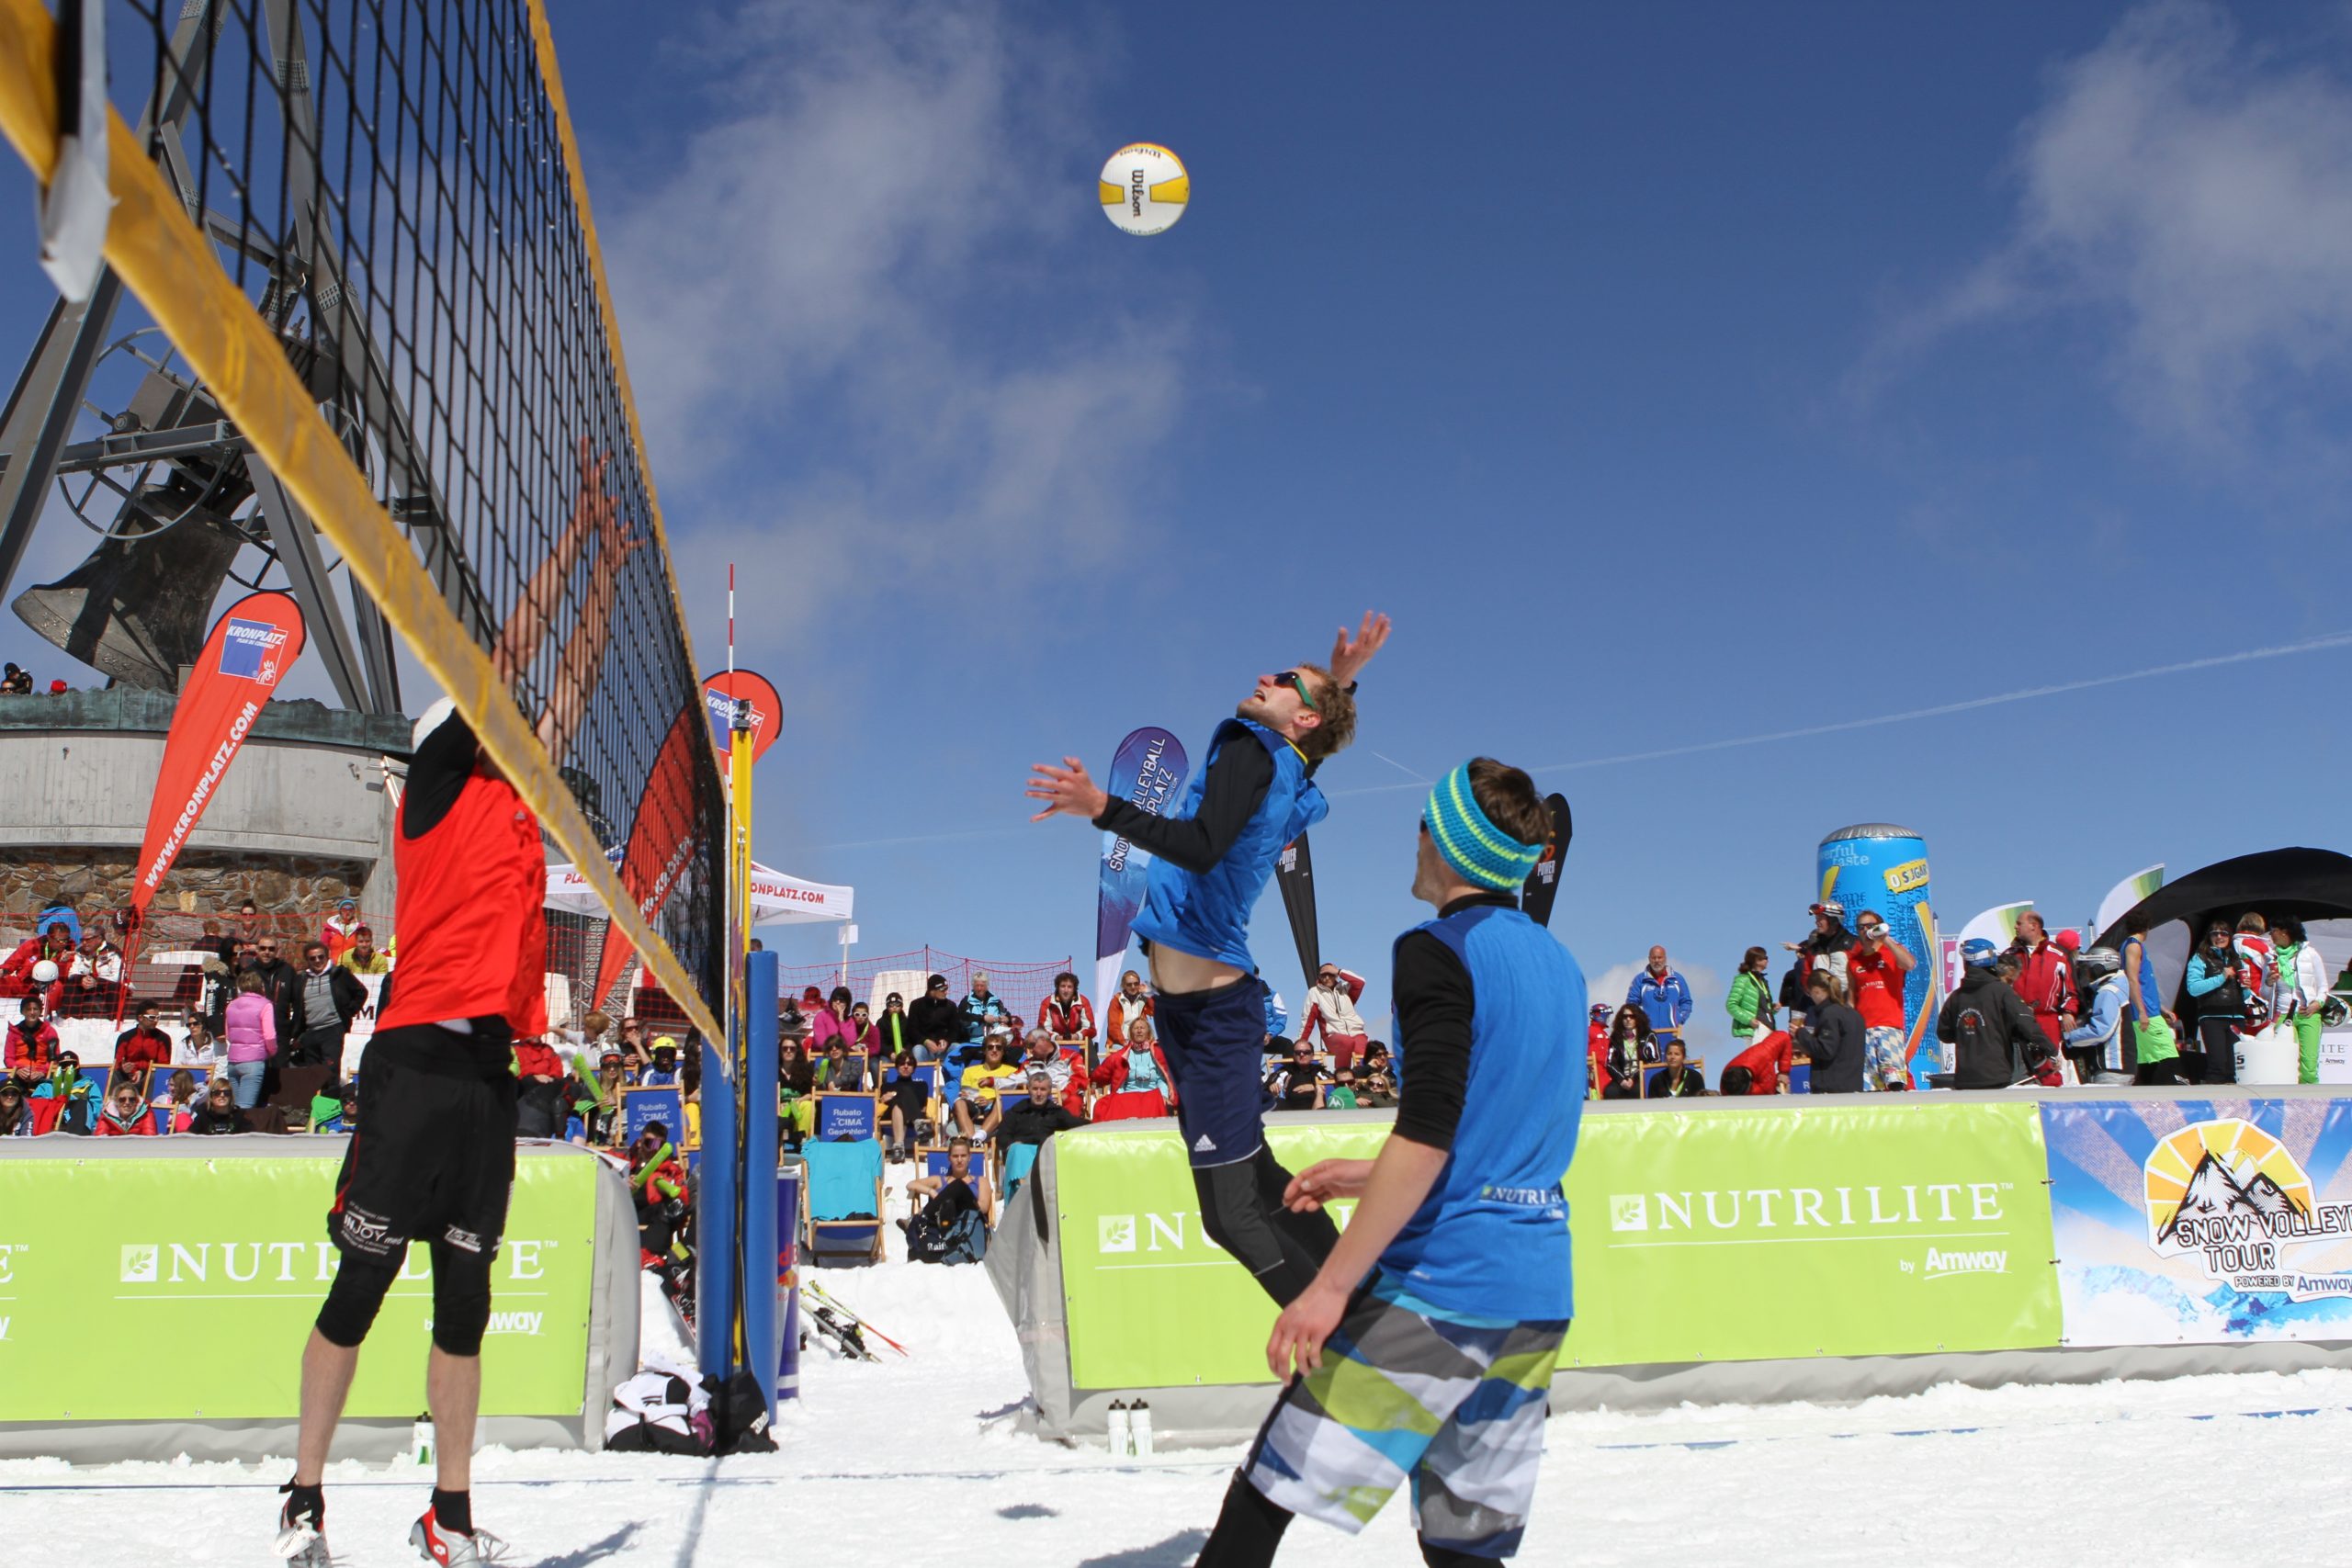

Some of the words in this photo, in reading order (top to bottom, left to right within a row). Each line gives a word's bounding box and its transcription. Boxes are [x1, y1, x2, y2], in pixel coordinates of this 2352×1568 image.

[1132, 168, 1145, 218] Wilson
[226, 626, 287, 645] KRONPLATZ
[143, 701, 258, 888] WWW.KRONPLATZ.COM
[1110, 837, 1130, 872] SNO
[1537, 860, 1555, 876] POWER
[1833, 854, 1870, 867] taste
[564, 873, 587, 884] PLA
[1655, 1183, 2004, 1230] NUTRILITE
[2176, 1214, 2250, 1247] SNOW
[1899, 1258, 1915, 1275] by
[1925, 1247, 2007, 1273] Amway
[2204, 1242, 2276, 1272] TOUR
[2234, 1275, 2281, 1288] POWERED
[2282, 1275, 2295, 1287] BY
